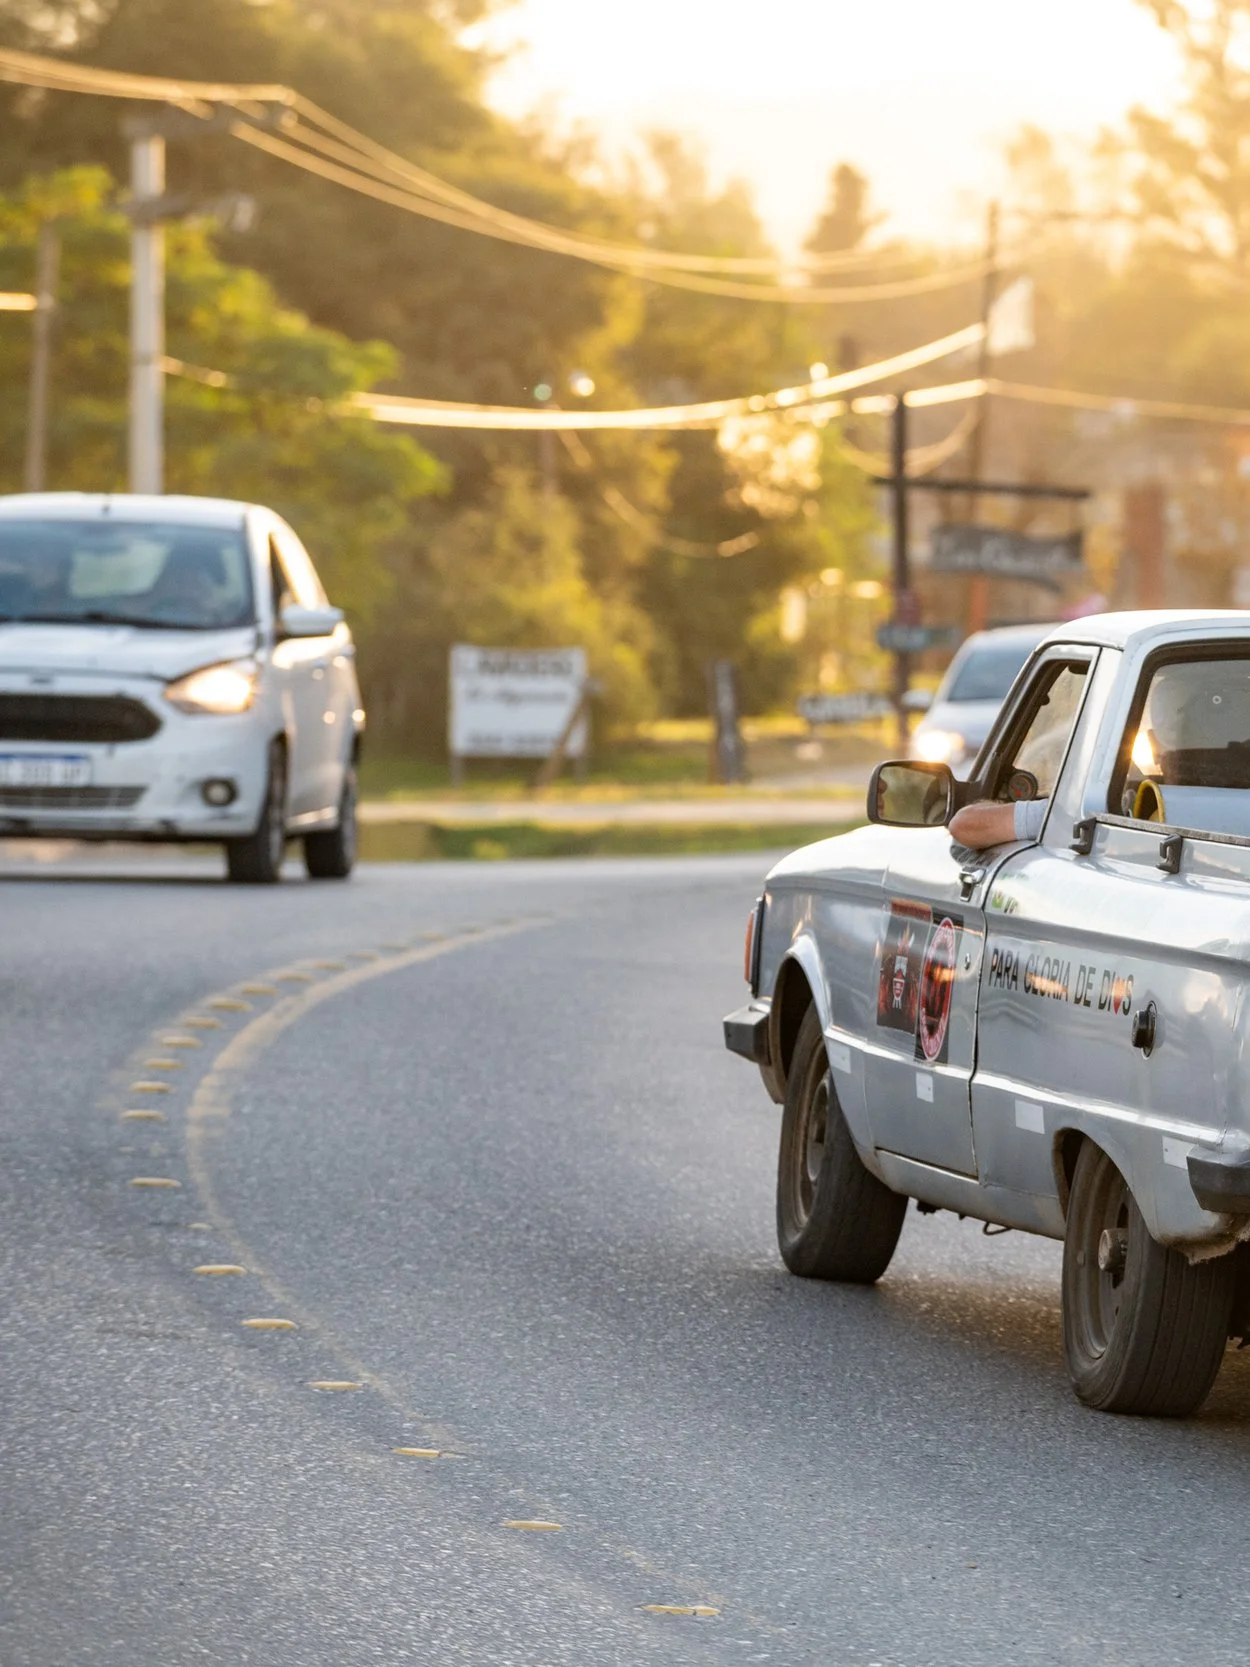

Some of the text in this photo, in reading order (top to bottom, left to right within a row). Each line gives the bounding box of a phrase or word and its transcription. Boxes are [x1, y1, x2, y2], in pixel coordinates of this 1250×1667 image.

[988, 948, 1019, 991] PARA
[1024, 953, 1070, 1001] GLORIA
[1073, 964, 1097, 1008] DE
